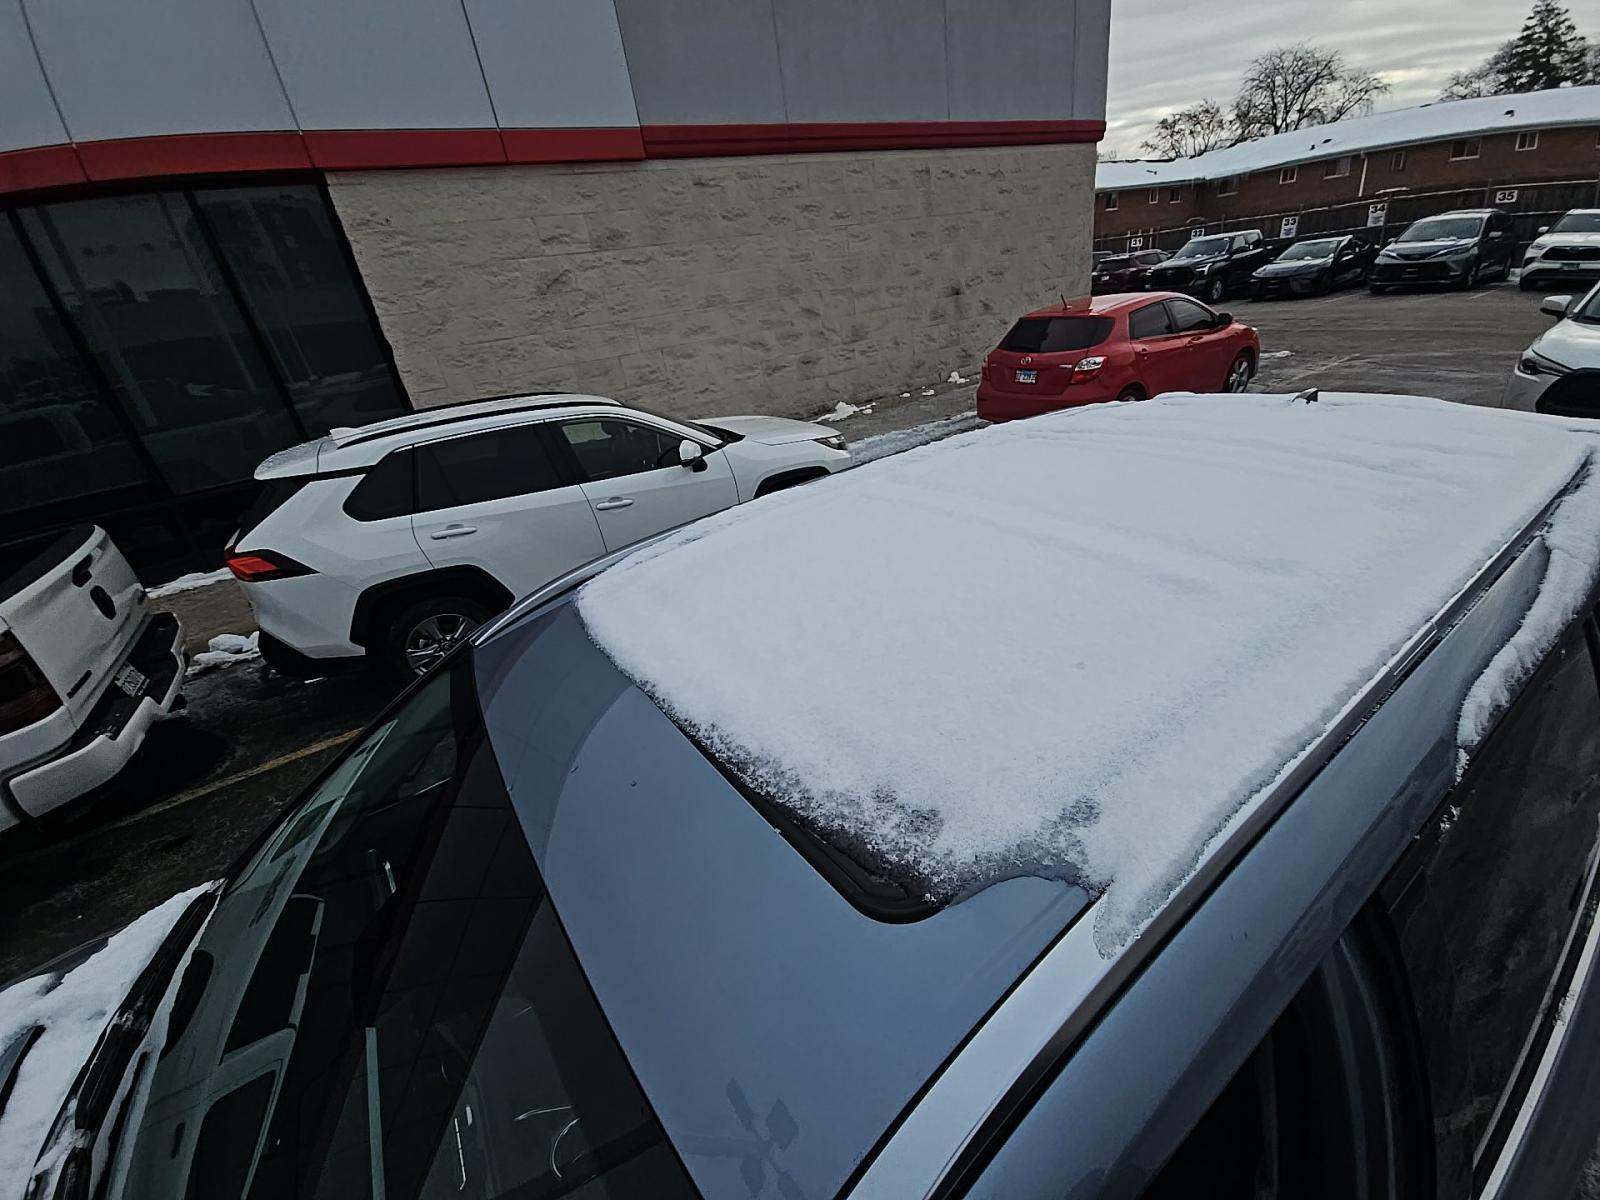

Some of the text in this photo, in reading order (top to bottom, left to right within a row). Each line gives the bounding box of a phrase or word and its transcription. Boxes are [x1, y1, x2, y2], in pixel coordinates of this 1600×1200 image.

[1498, 191, 1515, 201] 35
[1371, 203, 1385, 213] 34
[1284, 218, 1297, 226] 33
